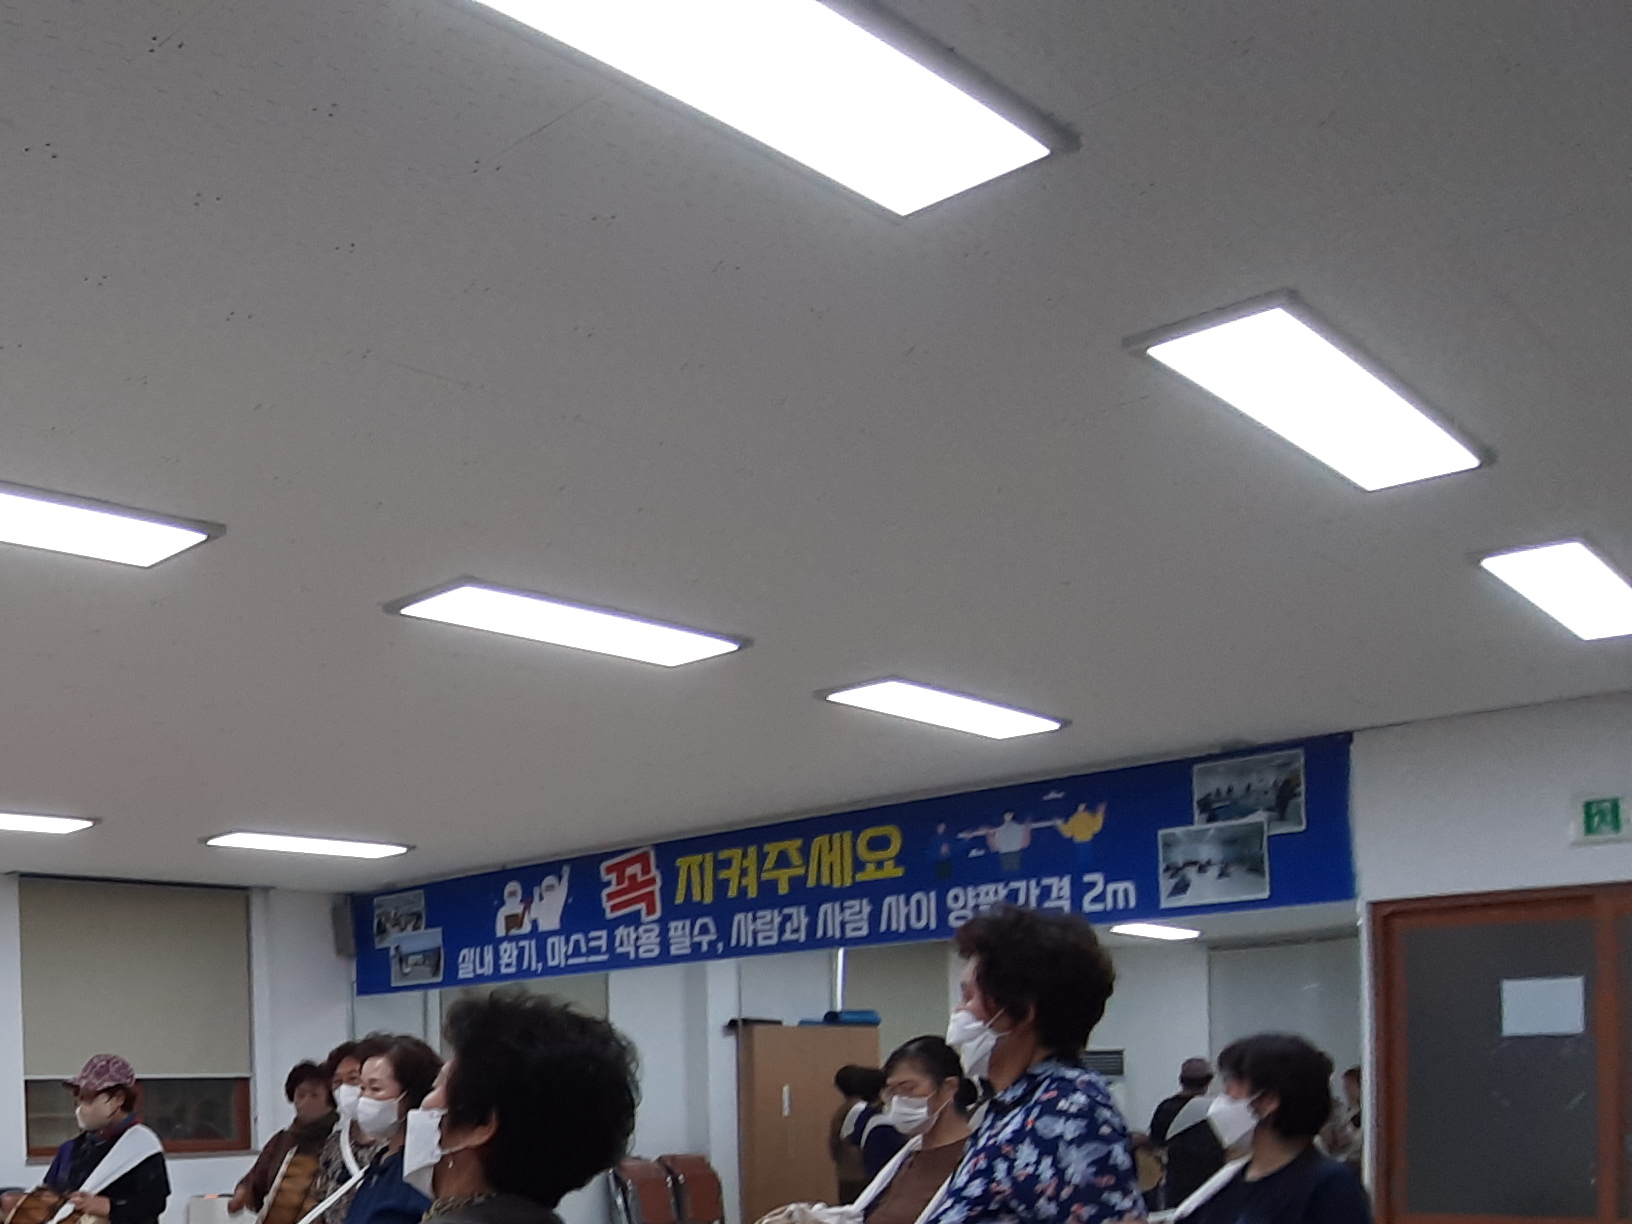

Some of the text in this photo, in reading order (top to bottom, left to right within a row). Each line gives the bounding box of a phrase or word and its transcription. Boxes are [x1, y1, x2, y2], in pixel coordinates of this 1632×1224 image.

[600, 824, 906, 922] 꼭 지켜주세요
[457, 943, 493, 980] 실내
[499, 934, 543, 974] 환기,
[546, 930, 609, 968] 마스크
[614, 923, 661, 960] 착용
[668, 916, 725, 955] 필수,
[730, 905, 810, 948] 사람과
[816, 898, 873, 939] 사람
[879, 891, 938, 934] 사이
[1081, 871, 1138, 913] 2m
